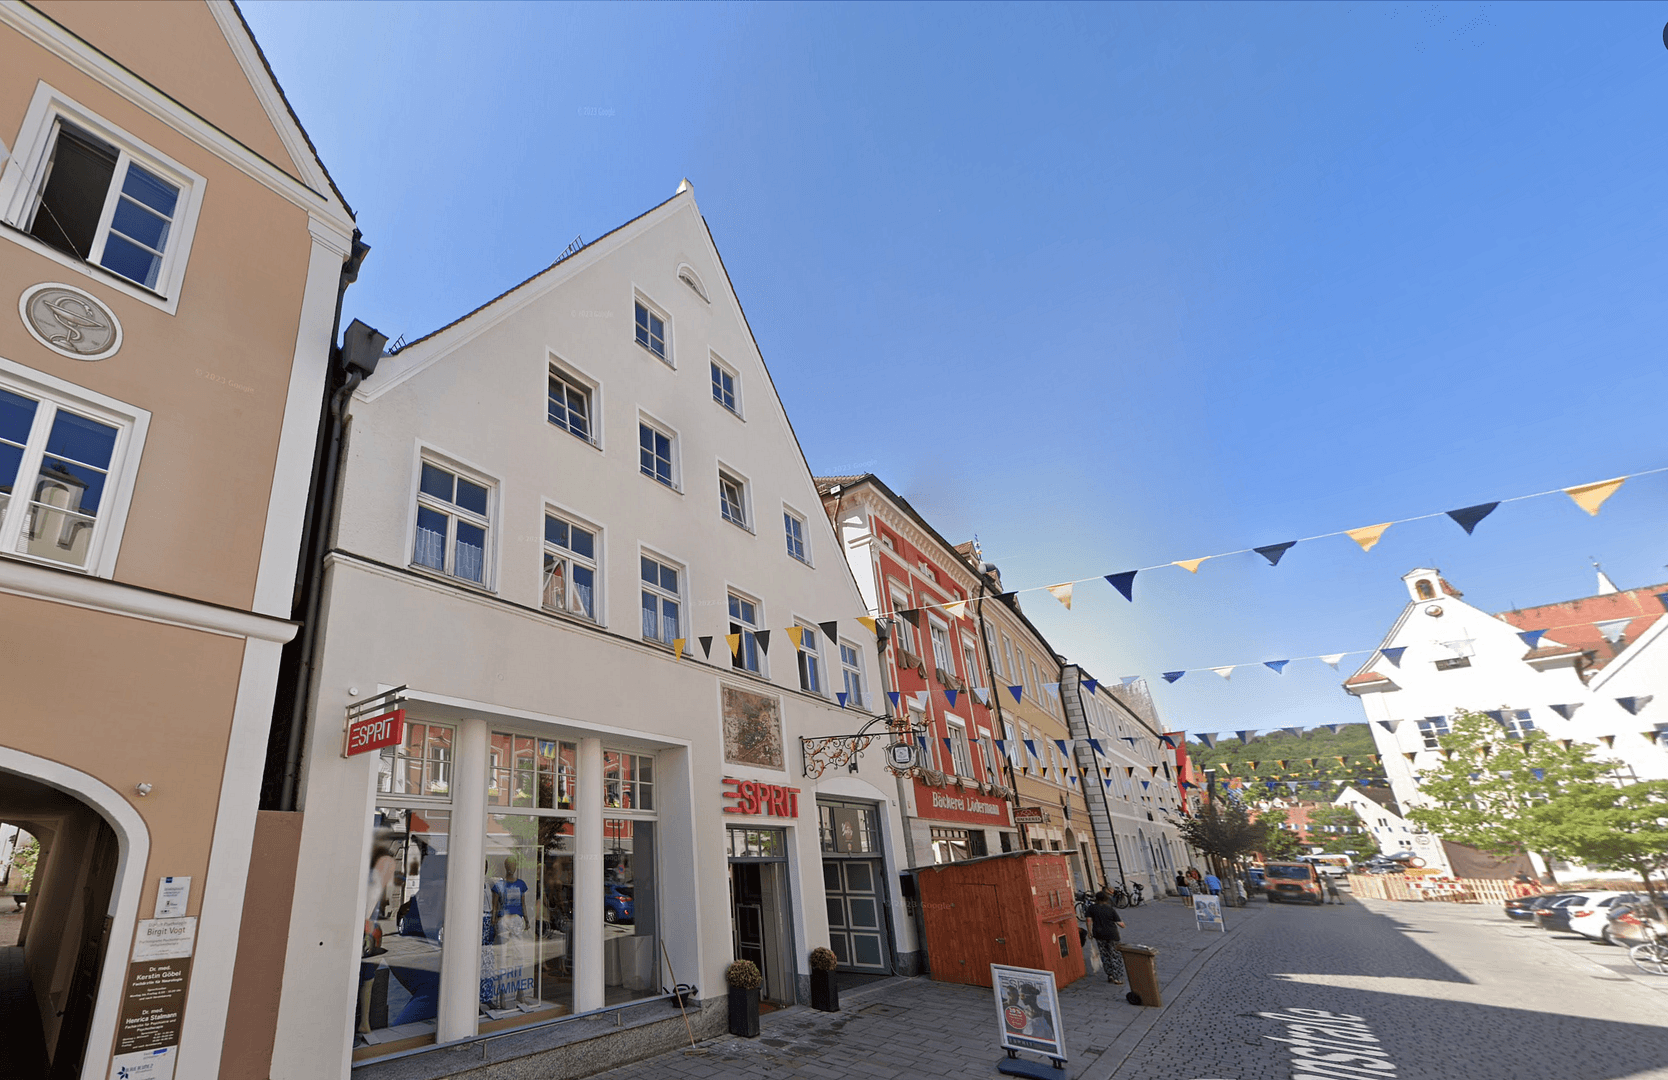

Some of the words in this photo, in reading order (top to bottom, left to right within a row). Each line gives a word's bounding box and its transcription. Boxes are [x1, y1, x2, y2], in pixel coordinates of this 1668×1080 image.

[351, 717, 394, 748] ESPRIT
[722, 778, 801, 818] ESPRIT
[147, 927, 167, 937] Birgit
[169, 926, 186, 935] Vogt
[136, 972, 160, 980] Kerstin
[492, 977, 534, 997] UMMER
